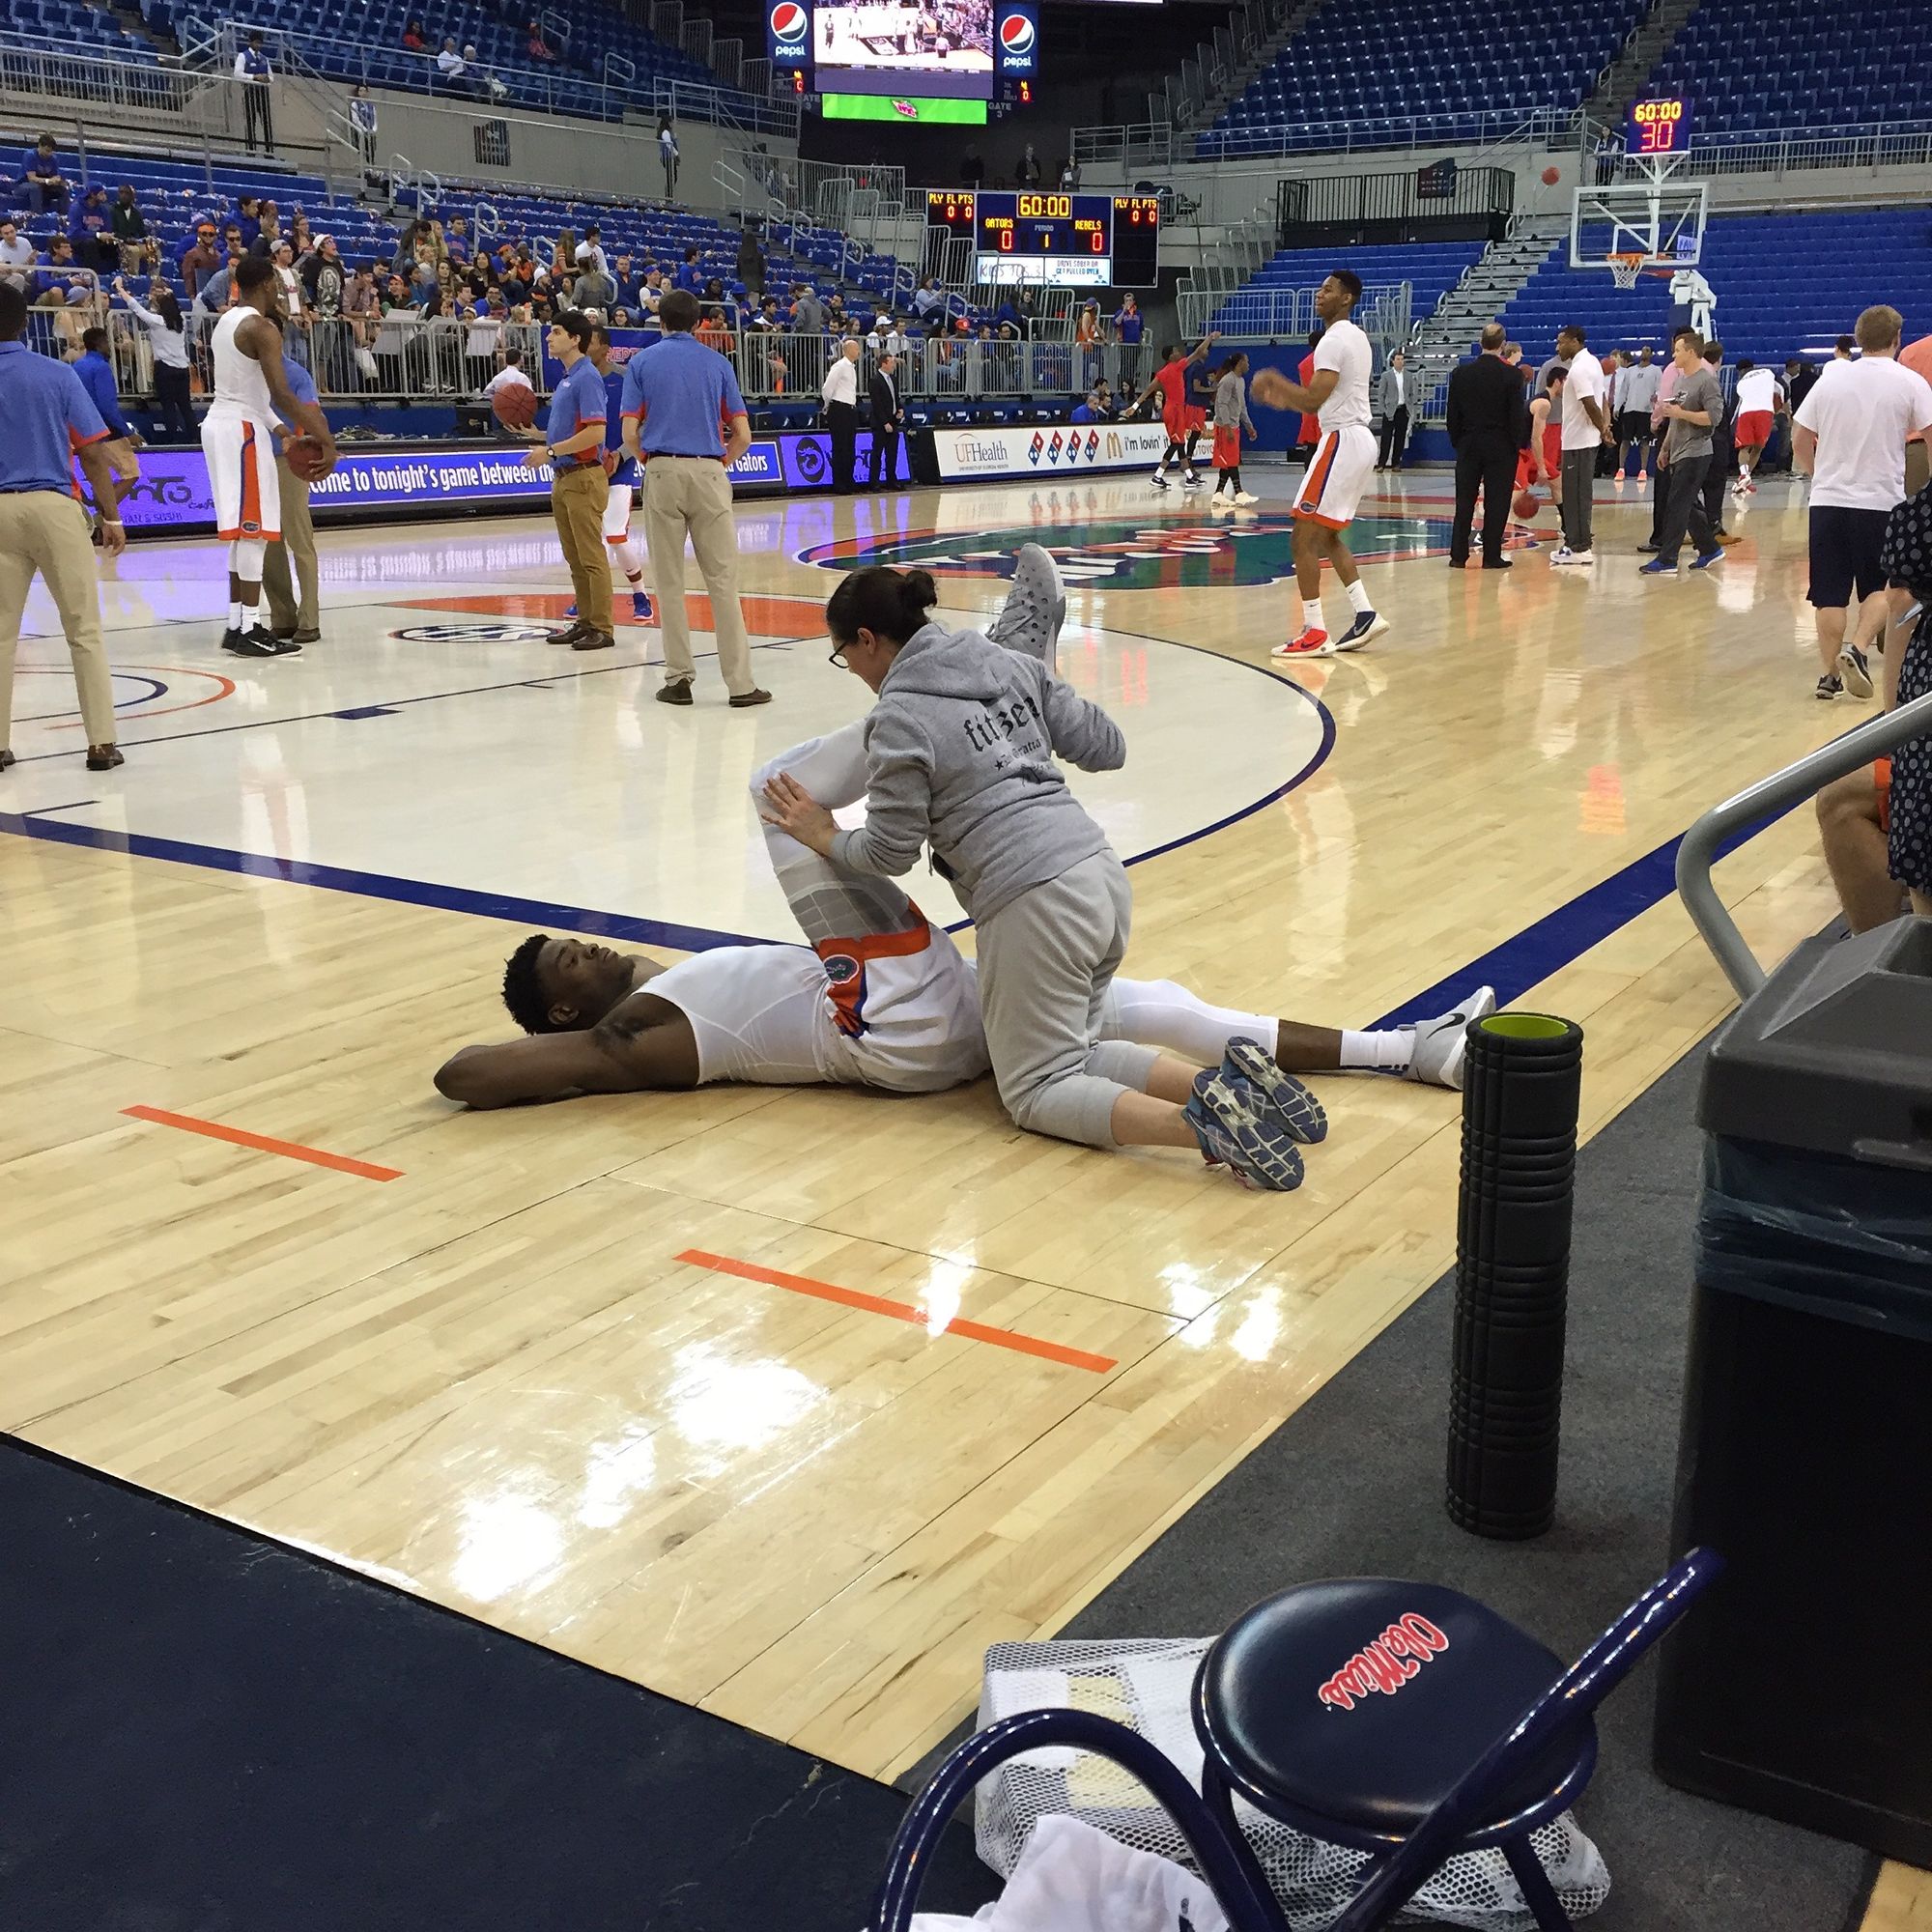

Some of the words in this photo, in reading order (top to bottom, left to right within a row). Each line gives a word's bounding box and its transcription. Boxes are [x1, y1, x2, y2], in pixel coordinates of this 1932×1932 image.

[775, 44, 806, 57] pepsi
[1003, 56, 1033, 68] pepsi
[987, 101, 1012, 111] GATE
[1634, 100, 1682, 123] 60:00
[1640, 120, 1673, 151] 30
[928, 192, 944, 204] PLY
[946, 193, 956, 205] FL
[957, 194, 974, 205] PTS
[1019, 195, 1069, 216] 60:00
[1114, 198, 1129, 209] PLY
[1131, 198, 1141, 209] FL
[1142, 199, 1157, 210] PTS
[947, 206, 955, 218] 0
[964, 206, 973, 218] 0
[1132, 210, 1140, 222] 0
[1149, 210, 1156, 222] 0
[984, 217, 1014, 229] GATORS
[1074, 219, 1102, 231] REBELS
[1001, 230, 1012, 250] 0
[1044, 233, 1050, 248] 1
[1092, 232, 1103, 252] 0
[1124, 436, 1138, 451] i'm
[1139, 435, 1161, 450] lovin'
[735, 453, 769, 473] Gators
[308, 471, 352, 494] come
[352, 467, 370, 491] to
[371, 464, 439, 494] tonight's
[439, 467, 480, 492] game
[479, 461, 537, 486] between
[1378, 1611, 1450, 1662] Ole
[1318, 1639, 1422, 1711] Miss
